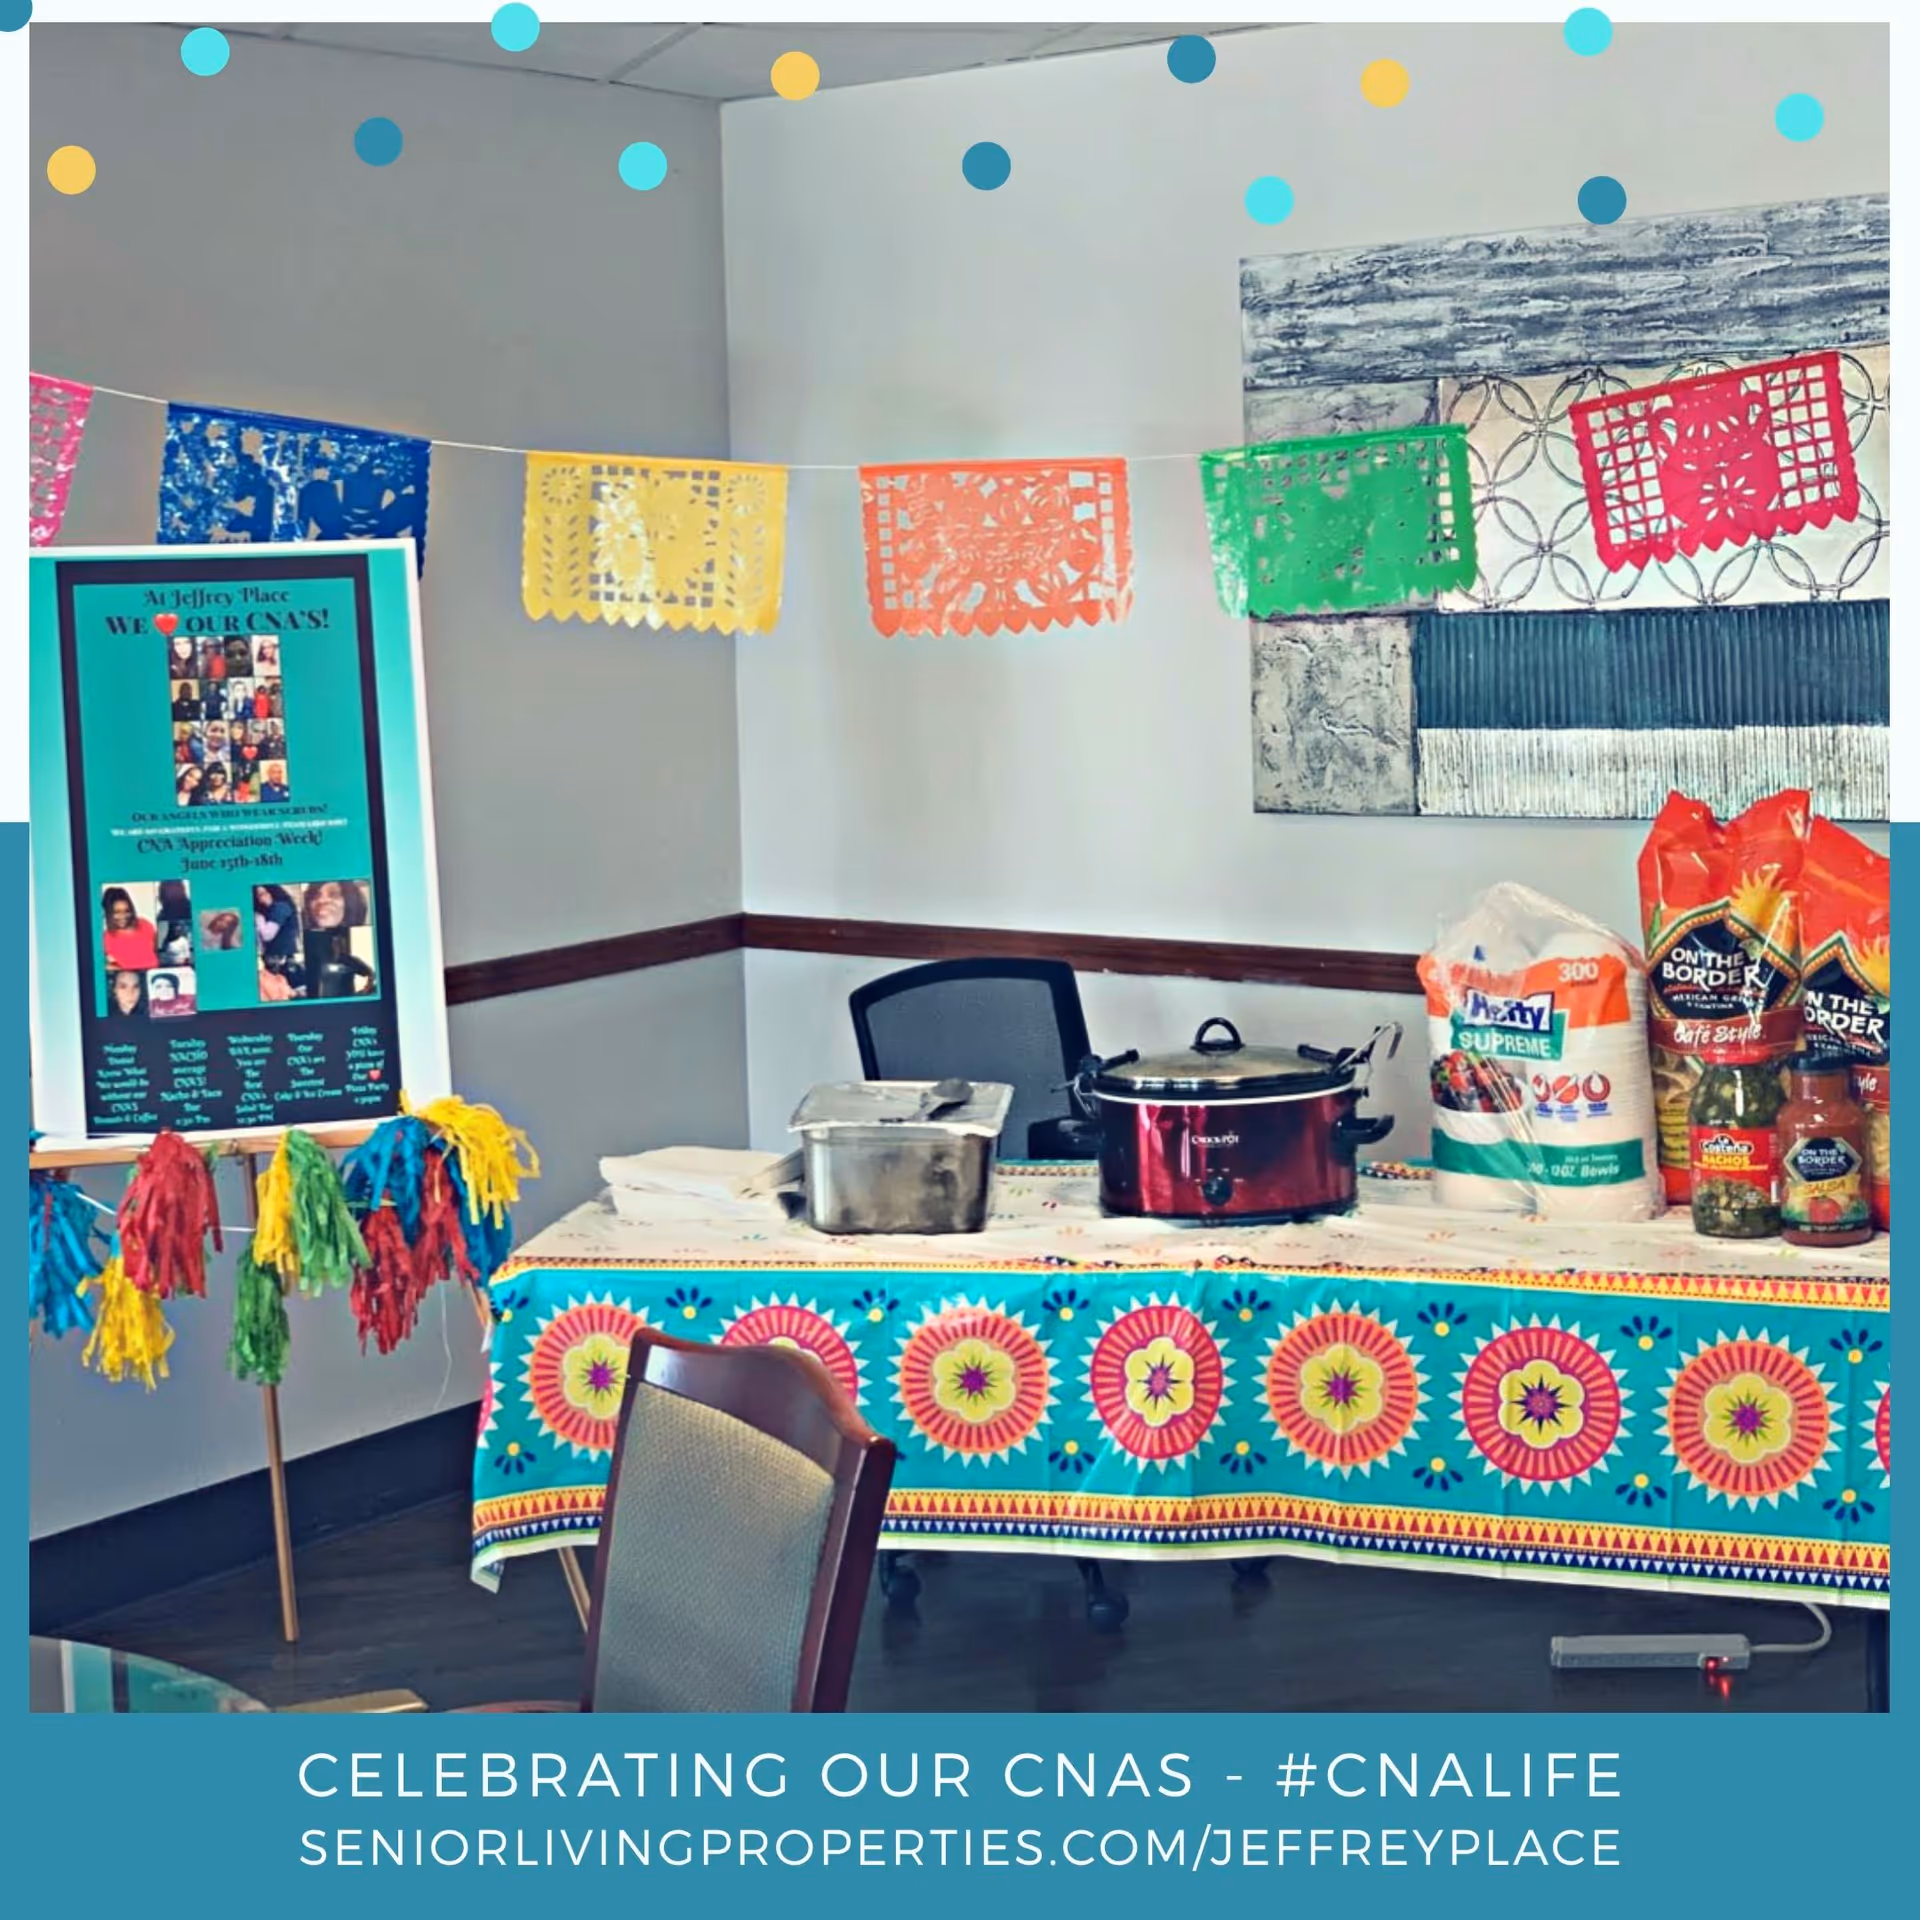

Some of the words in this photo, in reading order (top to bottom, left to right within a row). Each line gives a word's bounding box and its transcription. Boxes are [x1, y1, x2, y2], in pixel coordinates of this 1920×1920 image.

[143, 590, 166, 606] At
[171, 588, 233, 609] Jeffrey
[238, 586, 290, 603] Place
[106, 616, 148, 635] WE
[185, 615, 239, 633] OUR
[246, 608, 329, 631] CNA'S!
[137, 838, 173, 853] CNA
[180, 834, 272, 853] Appreciation
[181, 857, 216, 873] June
[1671, 947, 1698, 965] ON
[1702, 951, 1745, 968] THE
[1558, 962, 1598, 981] 300
[1662, 961, 1767, 992] BORDER
[1470, 991, 1546, 1032] Hefty
[1806, 990, 1824, 1007] N
[1829, 994, 1875, 1016] THE
[1804, 1005, 1886, 1044] ORDER
[1459, 1031, 1551, 1057] SUPREME
[1702, 1154, 1751, 1167] NACHOS
[1797, 1156, 1847, 1168] BORDER
[1801, 1148, 1816, 1157] ON
[1819, 1148, 1838, 1157] THE
[1580, 1162, 1620, 1178] Bowls
